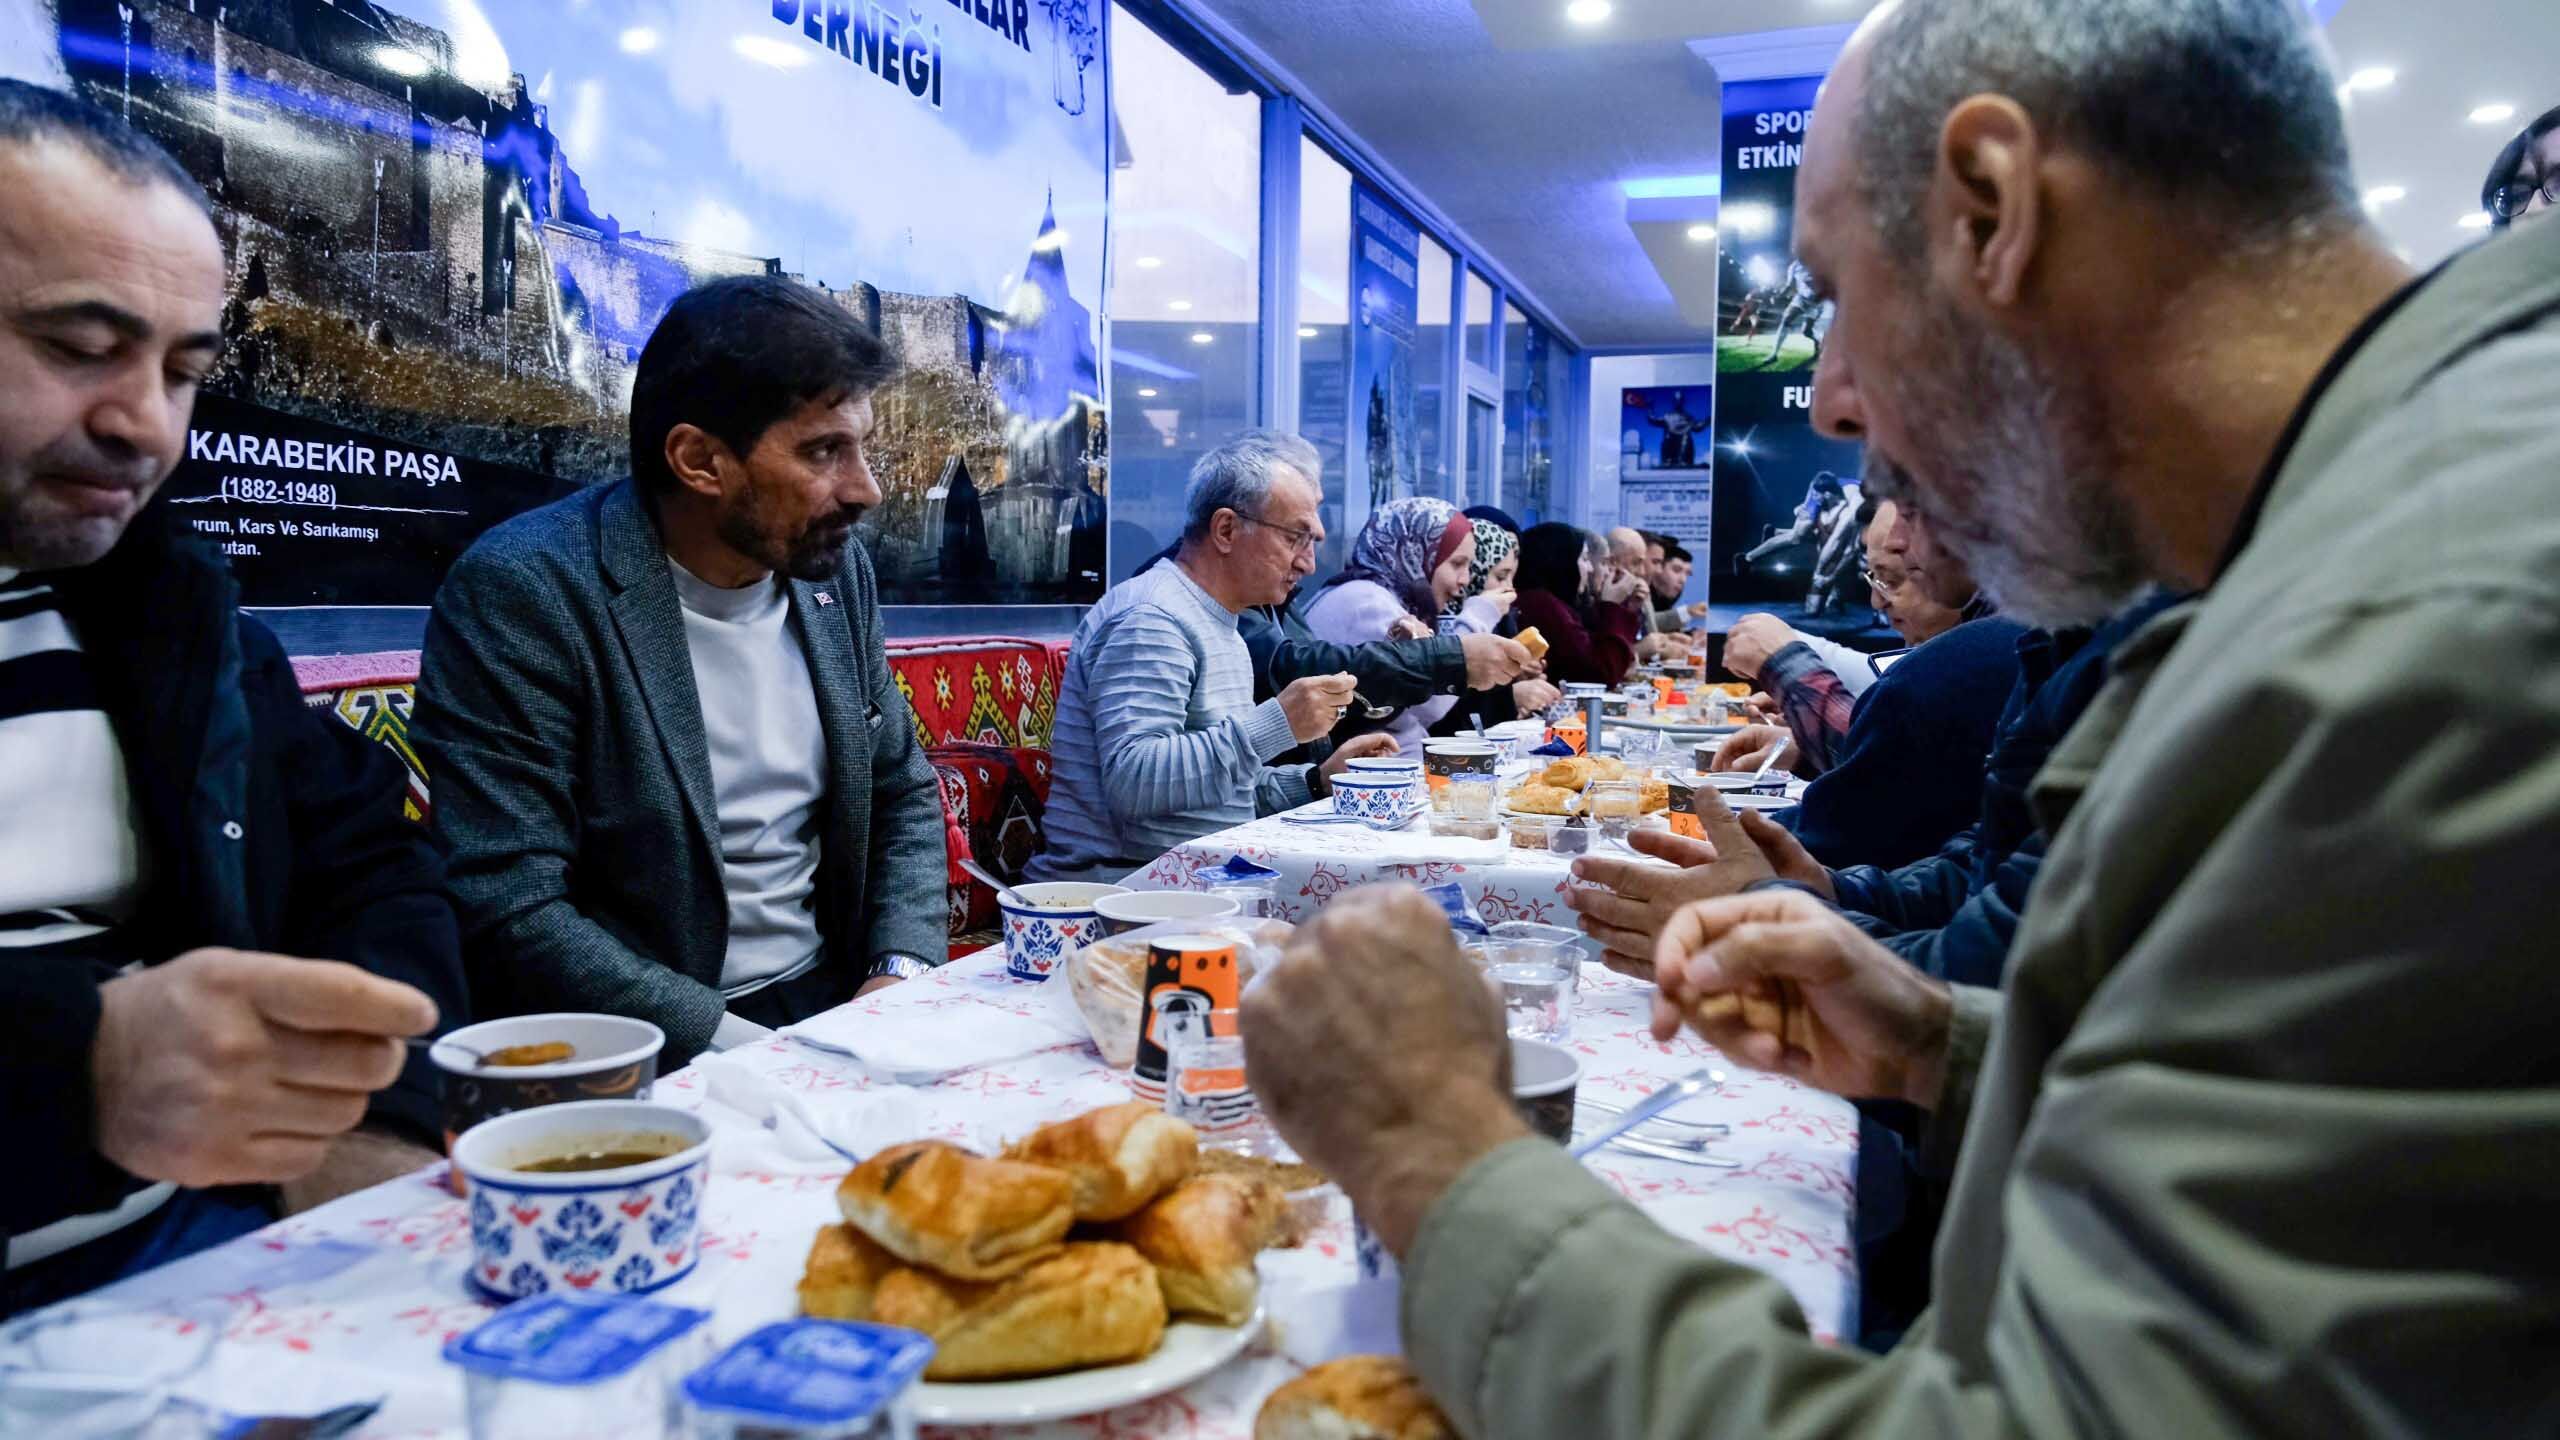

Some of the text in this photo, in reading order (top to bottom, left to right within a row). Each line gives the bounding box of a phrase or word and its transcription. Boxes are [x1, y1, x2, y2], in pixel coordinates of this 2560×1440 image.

[1784, 386, 1815, 408] FU
[190, 430, 462, 487] KARABEKİR PAŞA
[221, 476, 337, 509] (1882-1948)
[239, 518, 276, 535] Kars
[279, 520, 299, 536] Ve
[302, 521, 379, 543] Sarıkamışı
